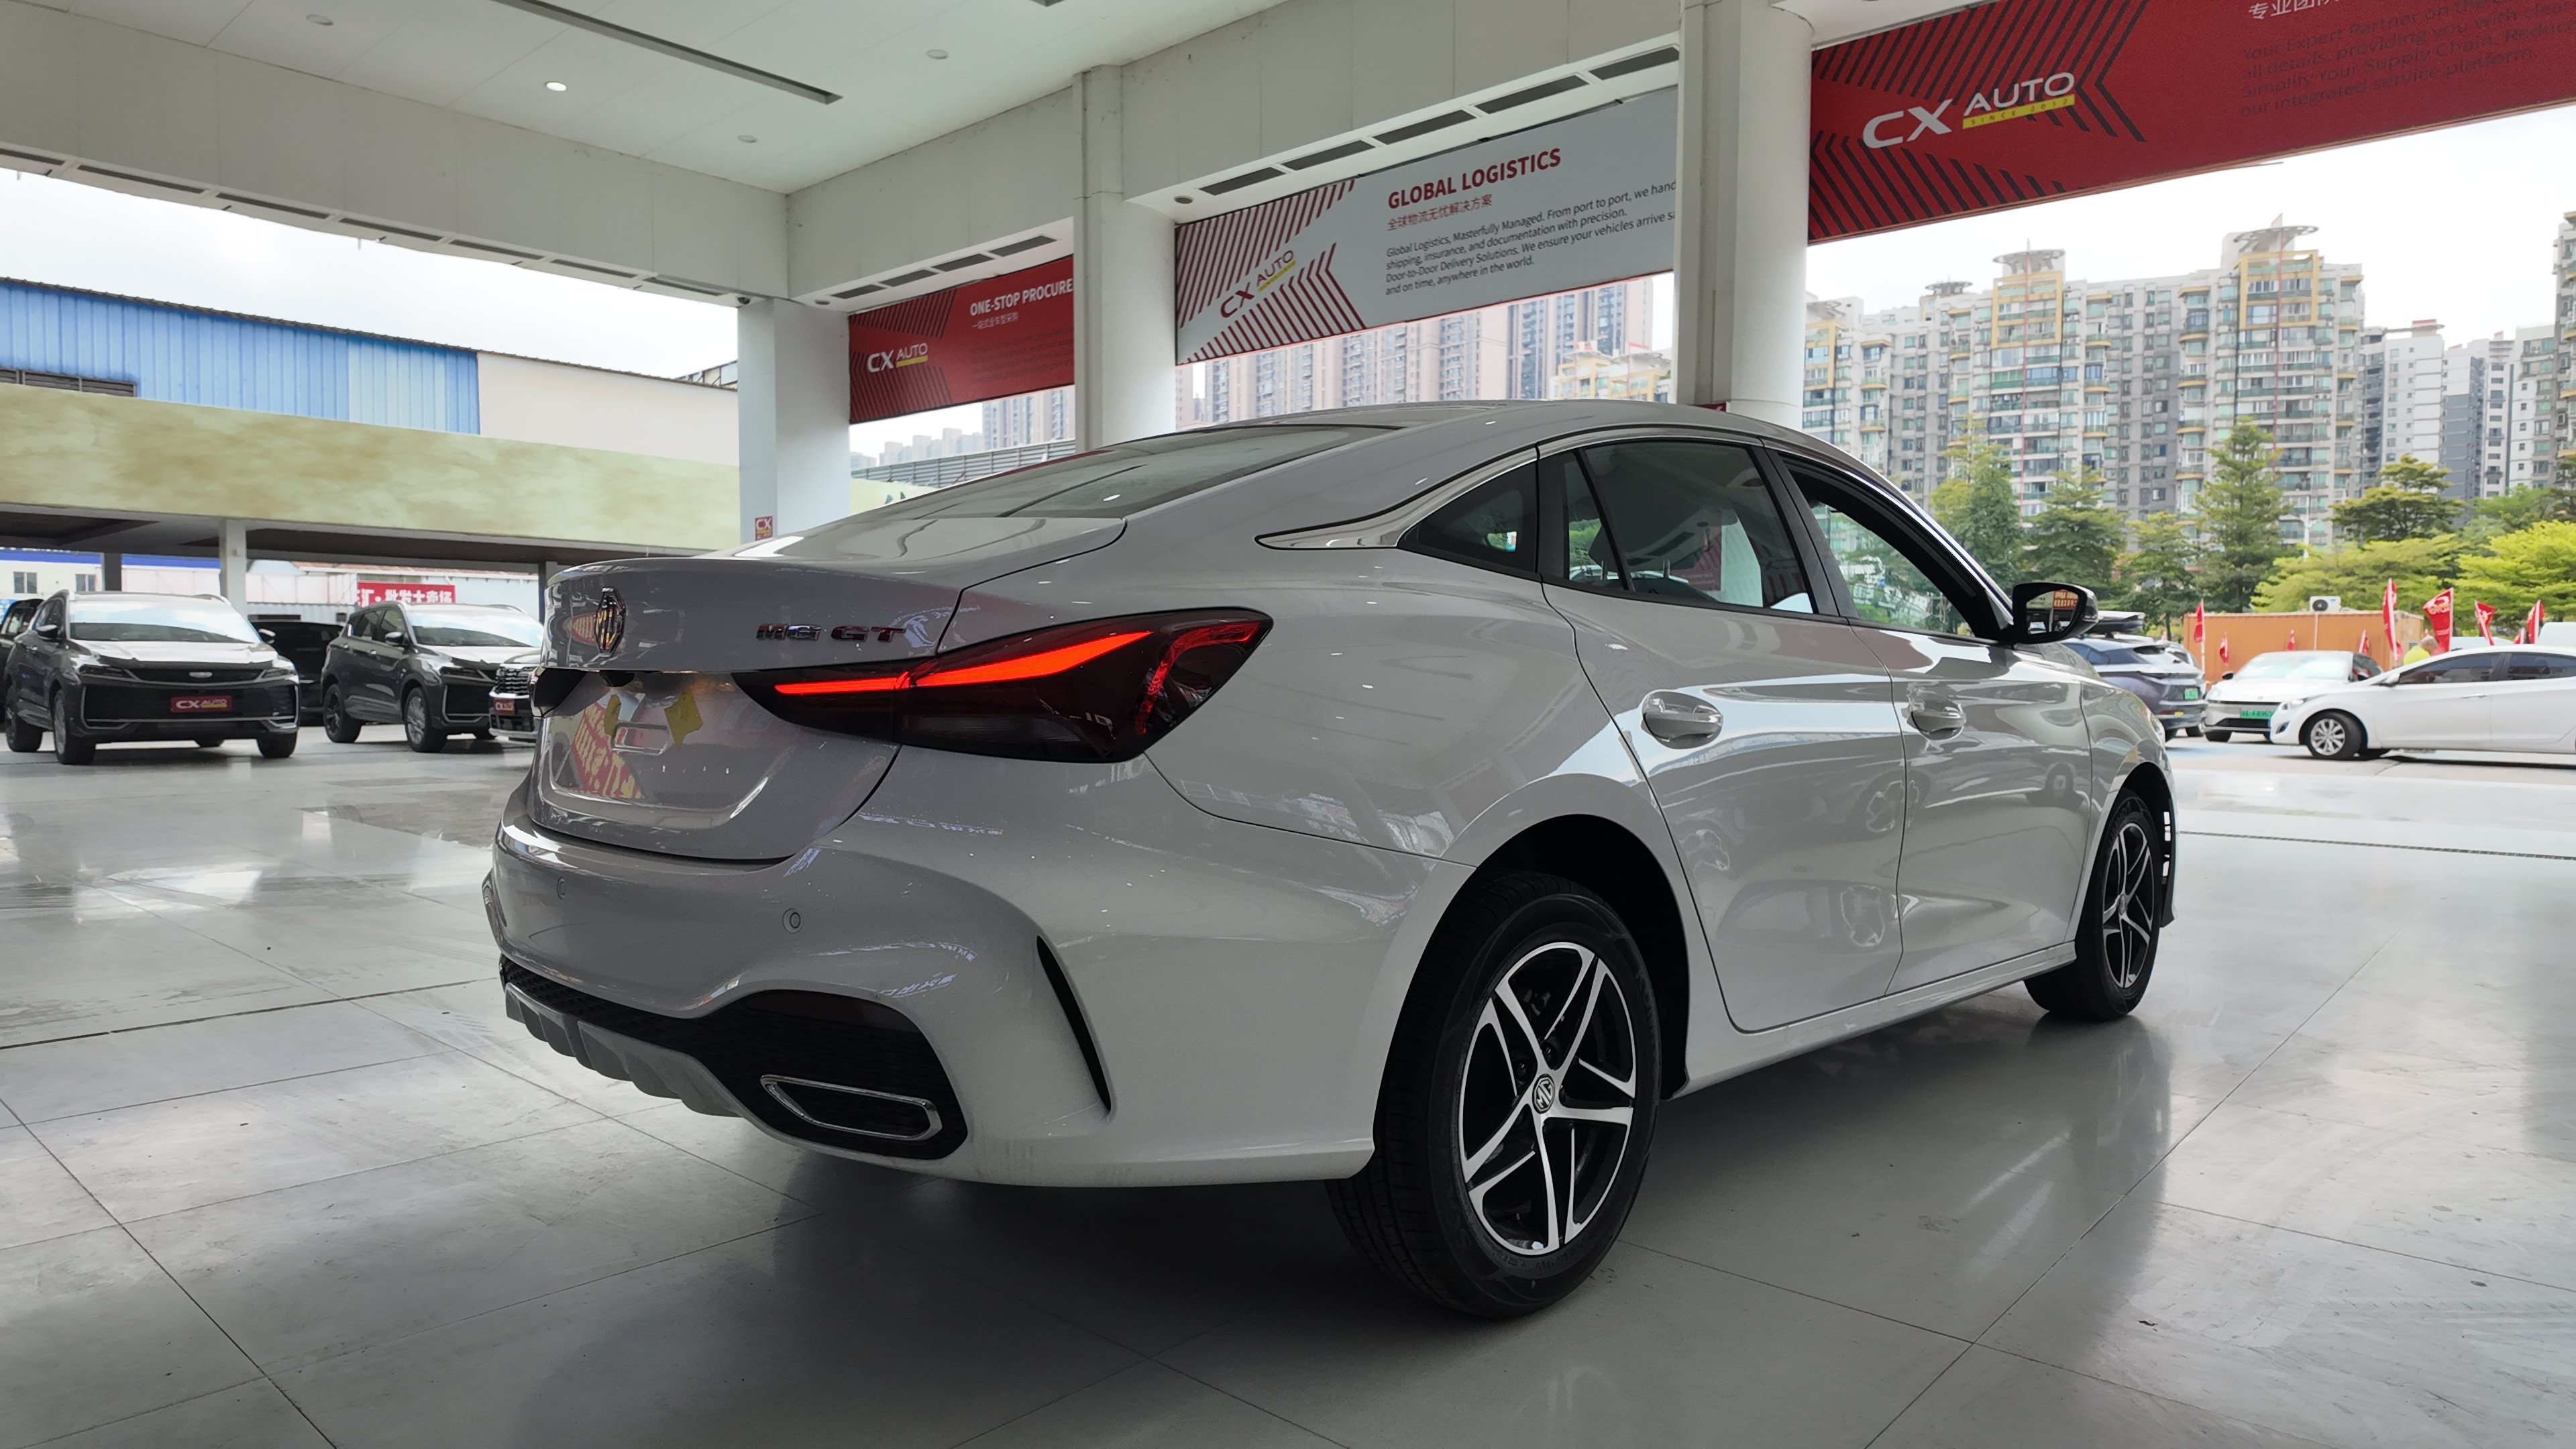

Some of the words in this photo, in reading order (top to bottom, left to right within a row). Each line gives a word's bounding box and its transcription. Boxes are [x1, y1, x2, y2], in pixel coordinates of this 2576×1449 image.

[2242, 63, 2263, 80] all
[2336, 30, 2427, 62] providing
[2433, 22, 2468, 40] you
[2286, 28, 2344, 52] Expert
[2349, 13, 2419, 35] Partner
[2364, 48, 2431, 72] Supply
[1862, 99, 1952, 149] CX
[1964, 72, 2075, 116] AUTO
[2240, 101, 2269, 117] our
[2273, 78, 2367, 109] integrated
[2373, 66, 2440, 90] service
[1970, 111, 2017, 125] SINCE
[1388, 176, 1457, 209] GLOBAL
[1462, 148, 1562, 191] LOGISTICS
[1386, 242, 1413, 258] Global
[1413, 236, 1452, 252] Logistics,
[1453, 223, 1500, 242] Masterfully
[1501, 211, 1545, 231] Managed.
[1547, 209, 1571, 220] From
[1573, 201, 1593, 217] port
[1596, 199, 1606, 209] to
[1608, 192, 1632, 208] port,
[1634, 189, 1649, 199] we
[1386, 256, 1424, 271] shipping,
[1424, 246, 1467, 262] insurance,
[1468, 238, 1485, 252] and
[1487, 224, 1556, 248] documentation
[1557, 217, 1578, 231] with
[1580, 208, 1627, 229] precision.
[1385, 264, 1440, 283] Door-to-Door
[1440, 257, 1475, 271] Delivery
[1521, 241, 1536, 253] We
[1537, 235, 1569, 250] ensure
[1570, 230, 1593, 246] your
[1594, 220, 1634, 237] vehicles
[1635, 213, 1666, 228] arrive
[1220, 281, 1255, 319] CX
[1256, 250, 1294, 288] AUTO
[1385, 283, 1401, 296] and
[1401, 283, 1413, 292] on
[1414, 279, 1436, 290] time,
[1437, 270, 1479, 286] anywhere
[1479, 266, 1489, 276] in
[1490, 262, 1505, 274] the
[1505, 255, 1535, 270] world.
[970, 292, 1020, 317] ONE-STOP
[1022, 278, 1073, 305] PROCURE
[867, 349, 895, 373] CX
[896, 342, 928, 362] AUTO
[756, 517, 771, 531] CX
[757, 624, 822, 641] MG
[830, 625, 906, 643] GT
[176, 700, 200, 709] CX
[1536, 1079, 1553, 1108] MG
